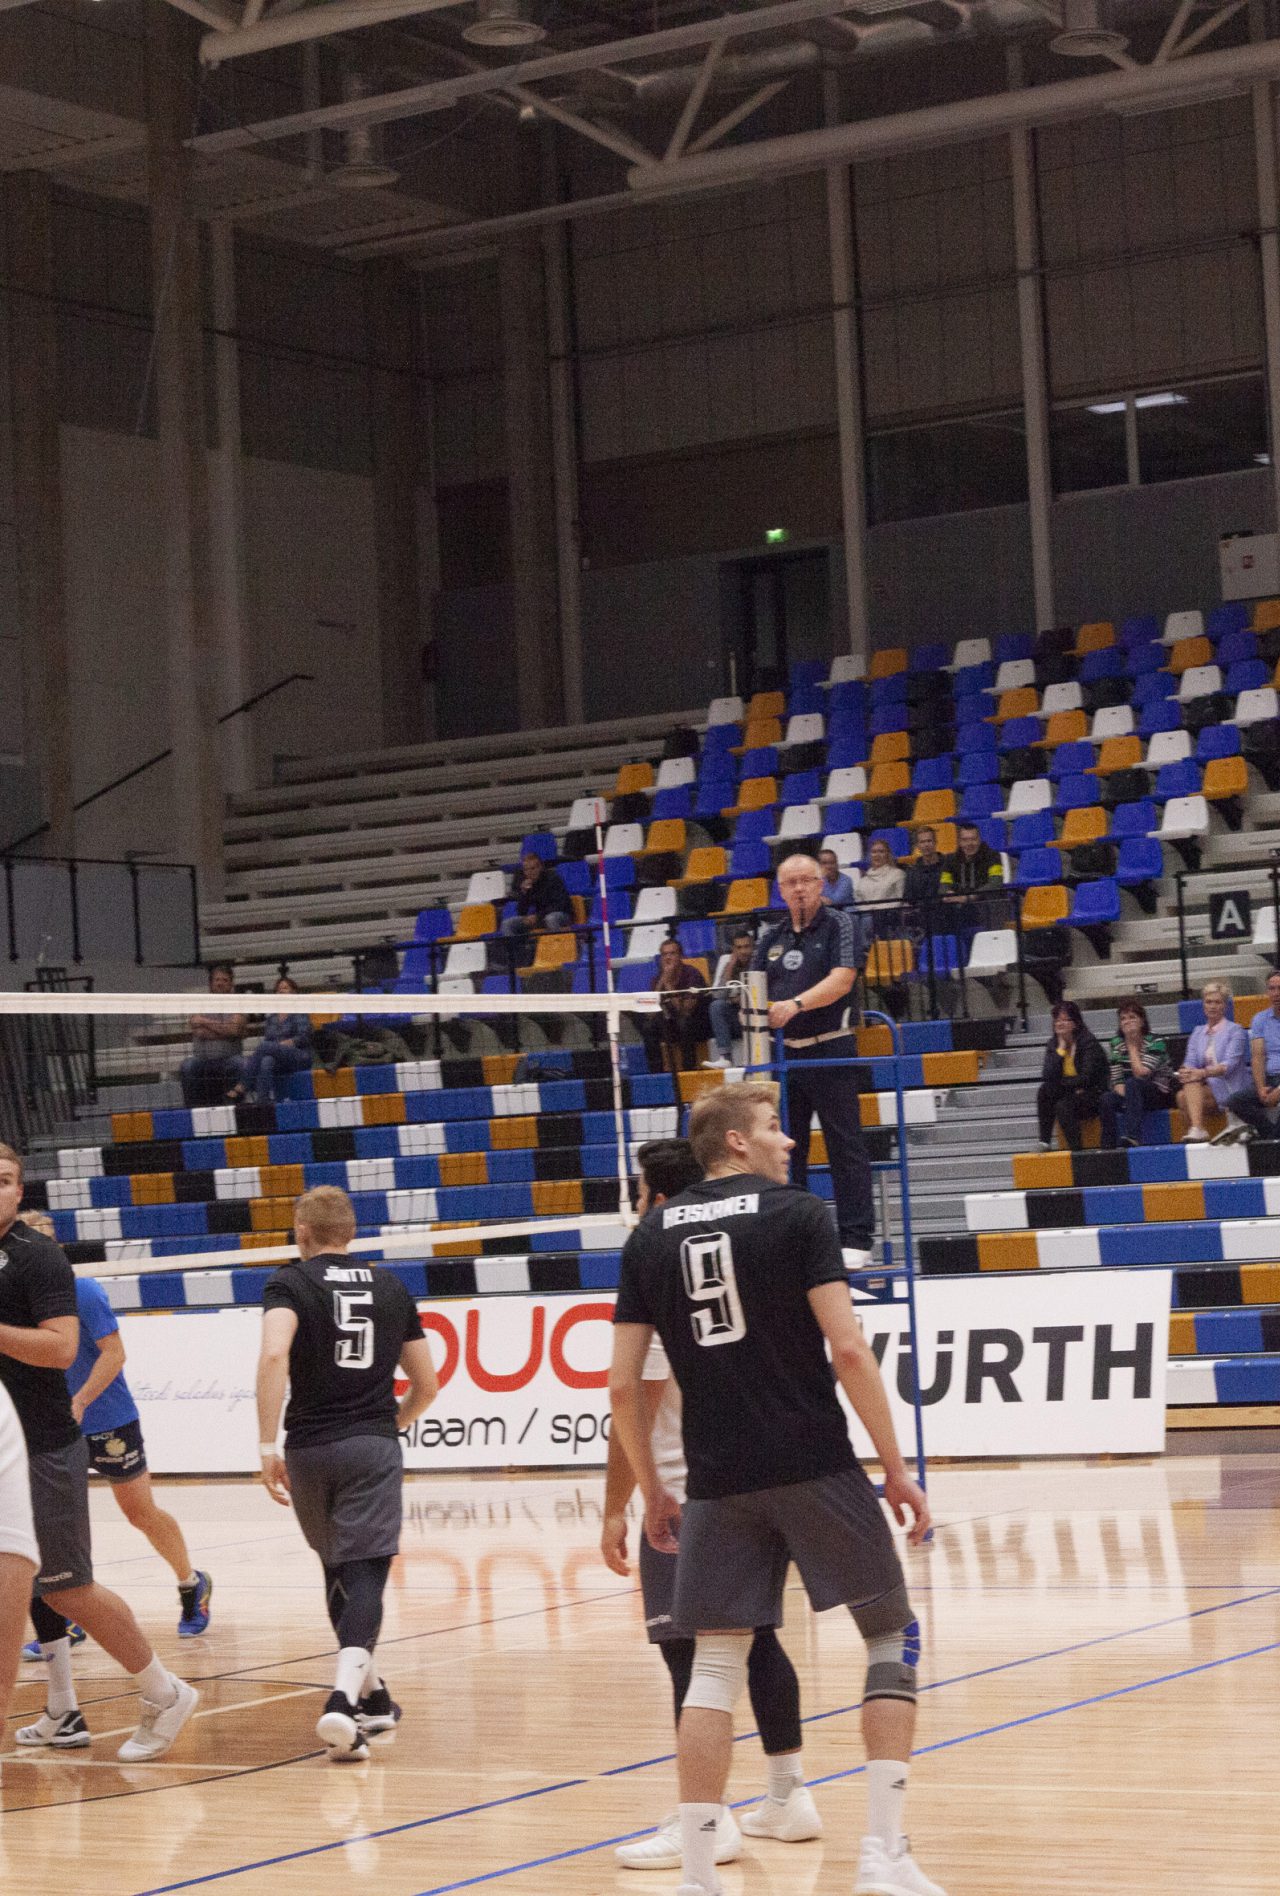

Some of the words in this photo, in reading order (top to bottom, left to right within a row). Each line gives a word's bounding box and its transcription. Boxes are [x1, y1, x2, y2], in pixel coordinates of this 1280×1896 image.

[1216, 899, 1246, 932] A
[680, 1231, 747, 1347] 9
[333, 1290, 374, 1368] 5
